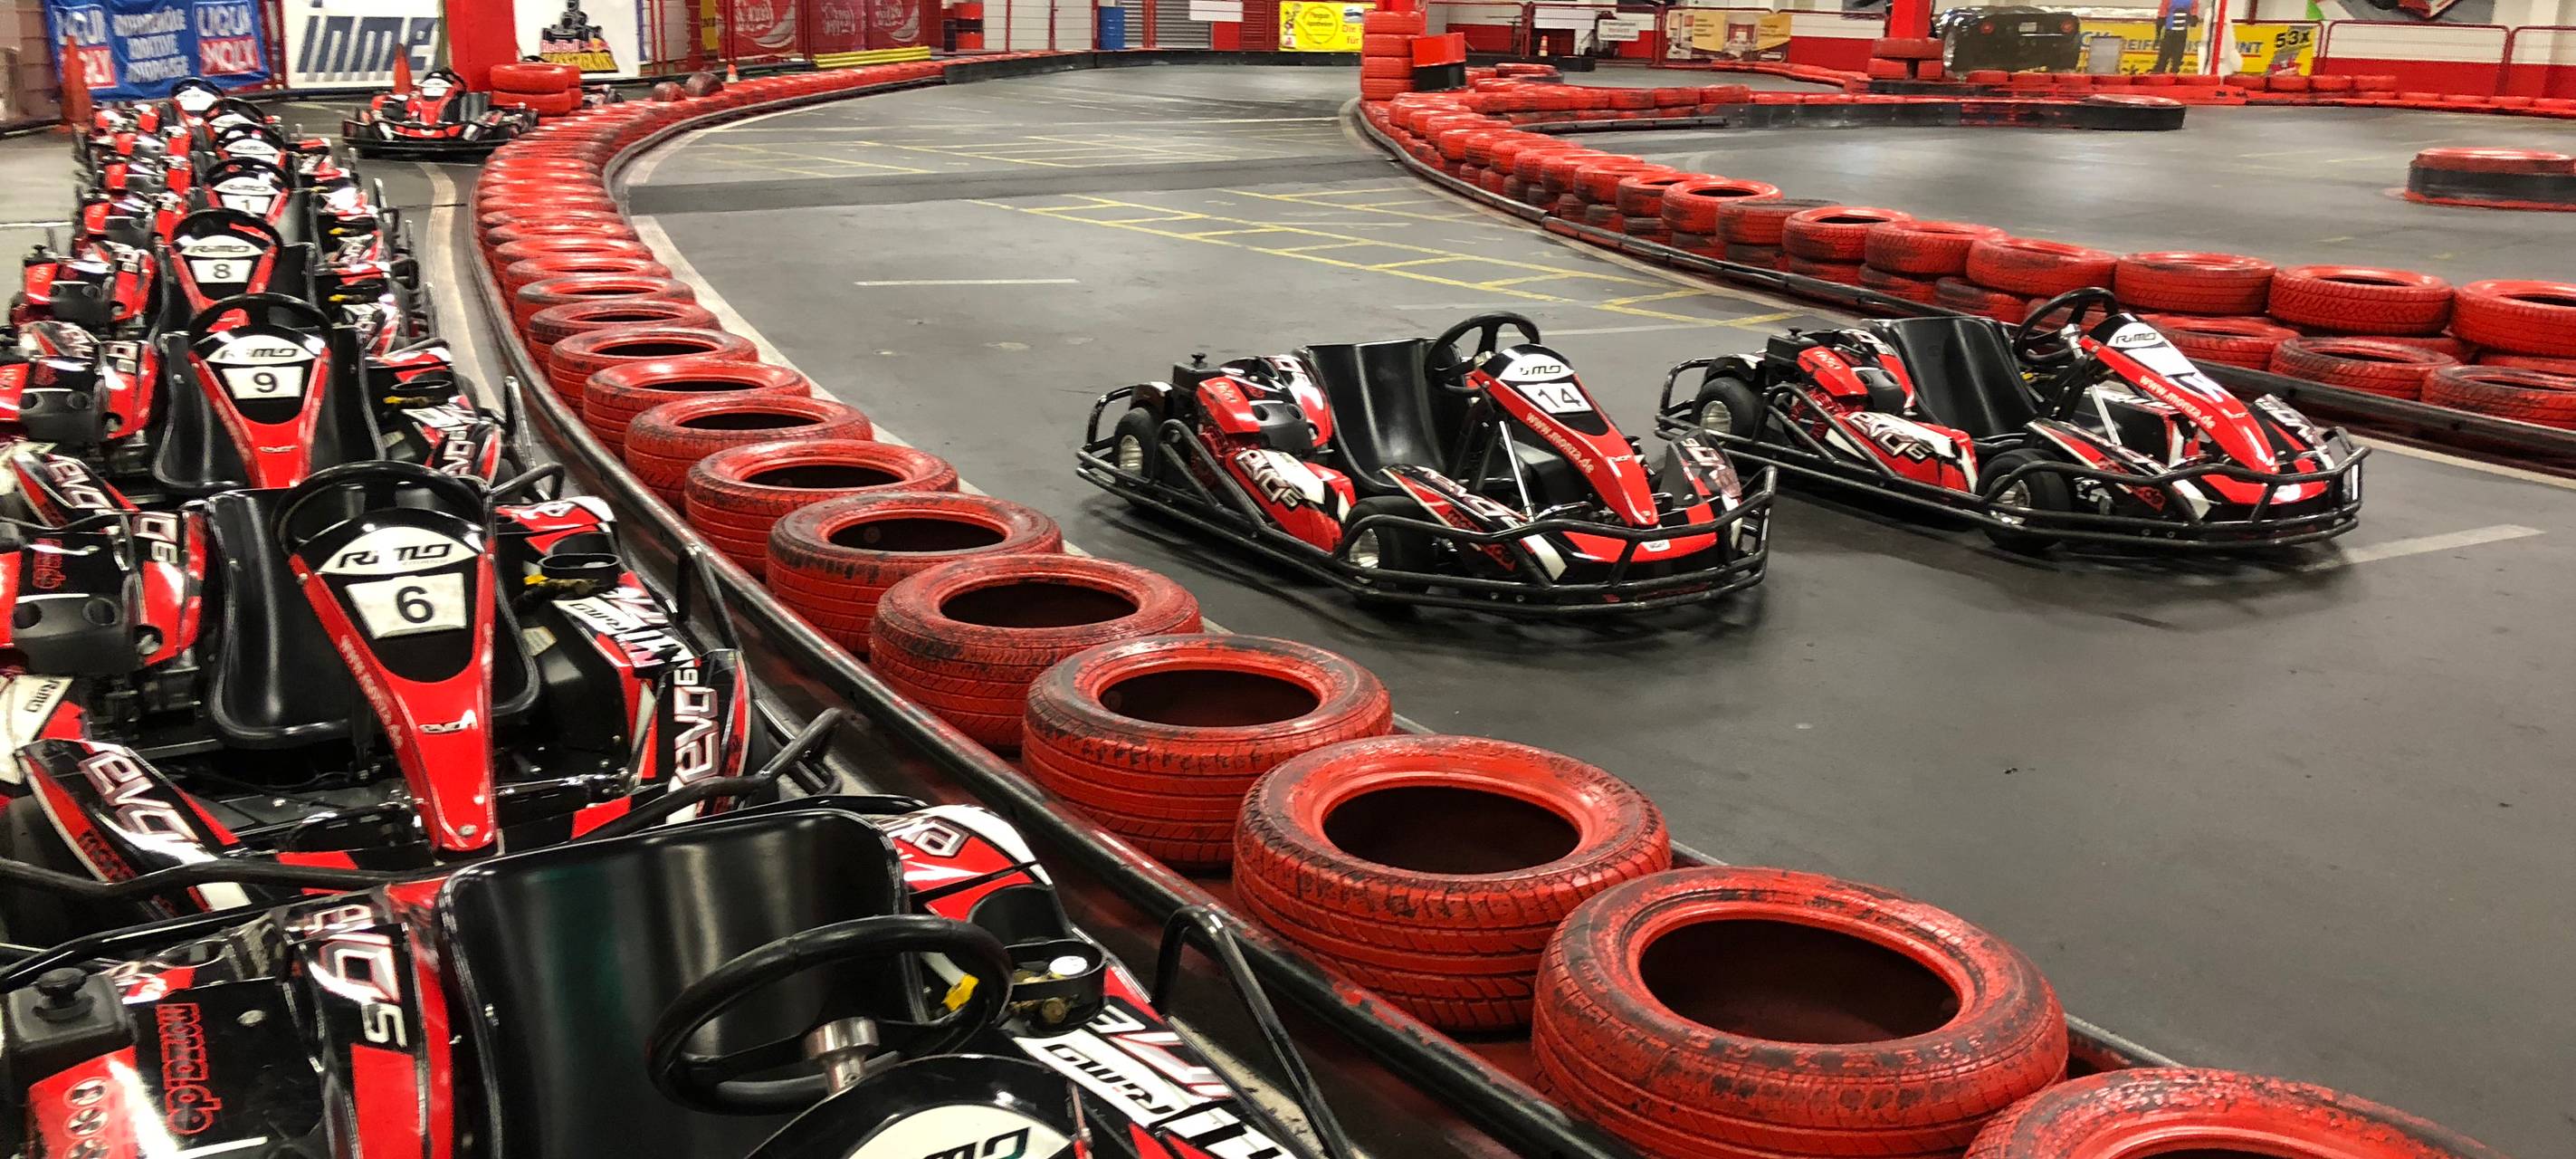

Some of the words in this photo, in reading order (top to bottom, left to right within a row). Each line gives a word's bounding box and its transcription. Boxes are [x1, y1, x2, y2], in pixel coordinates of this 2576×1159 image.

[212, 263, 232, 280] 8
[253, 372, 278, 393] 9
[1538, 388, 1583, 408] 14
[2139, 375, 2217, 430] www.monza.de
[1525, 411, 1596, 474] www.monza.de
[396, 585, 435, 624] 6
[156, 1001, 223, 1135] monza.de
